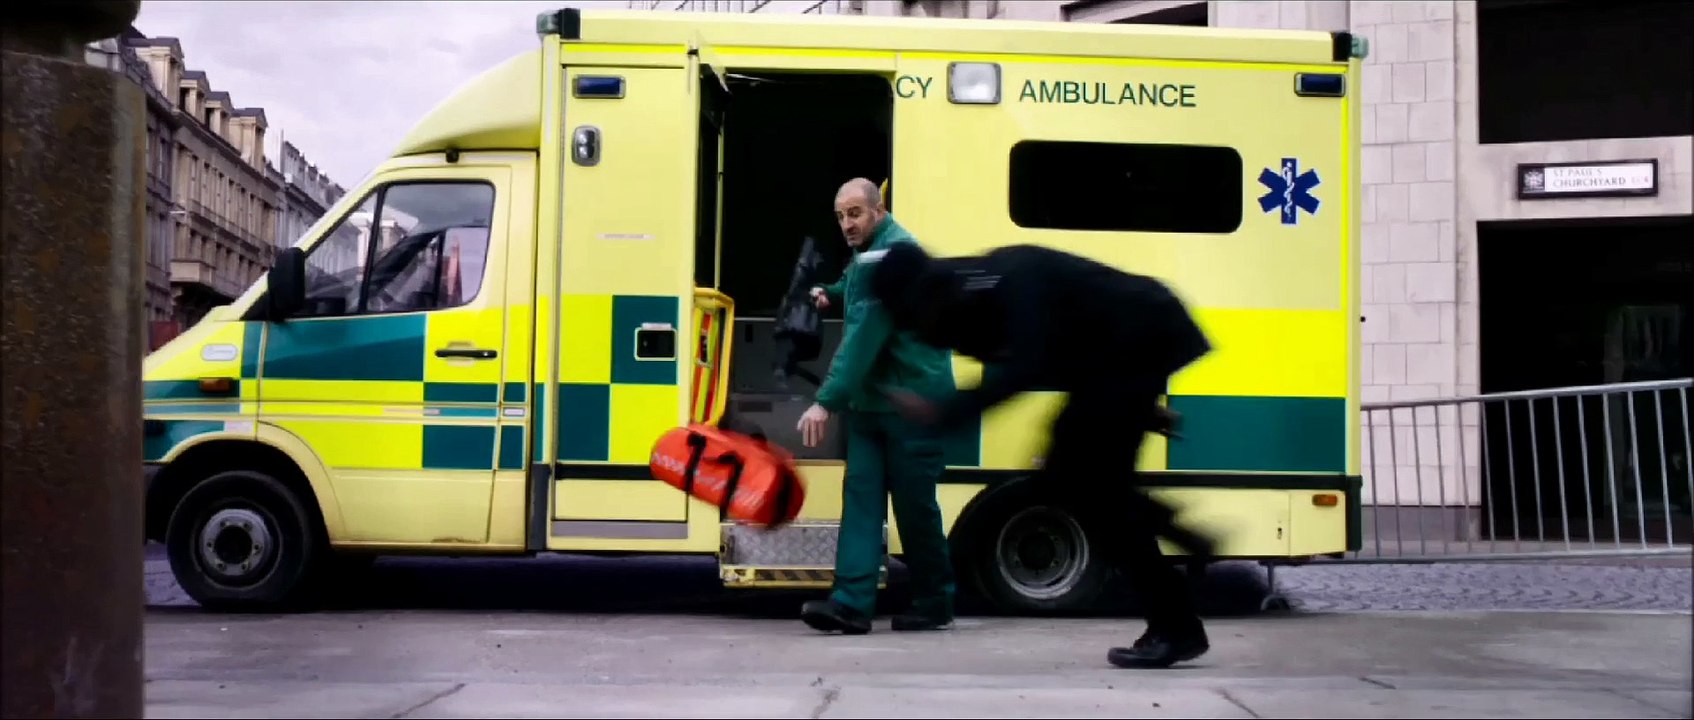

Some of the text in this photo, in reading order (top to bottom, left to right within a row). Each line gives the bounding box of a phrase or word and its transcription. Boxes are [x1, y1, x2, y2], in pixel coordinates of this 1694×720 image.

[896, 75, 1198, 108] CY AMBULANCE
[1568, 167, 1603, 177] PAULS
[1552, 176, 1626, 188] CHURCHYARD
